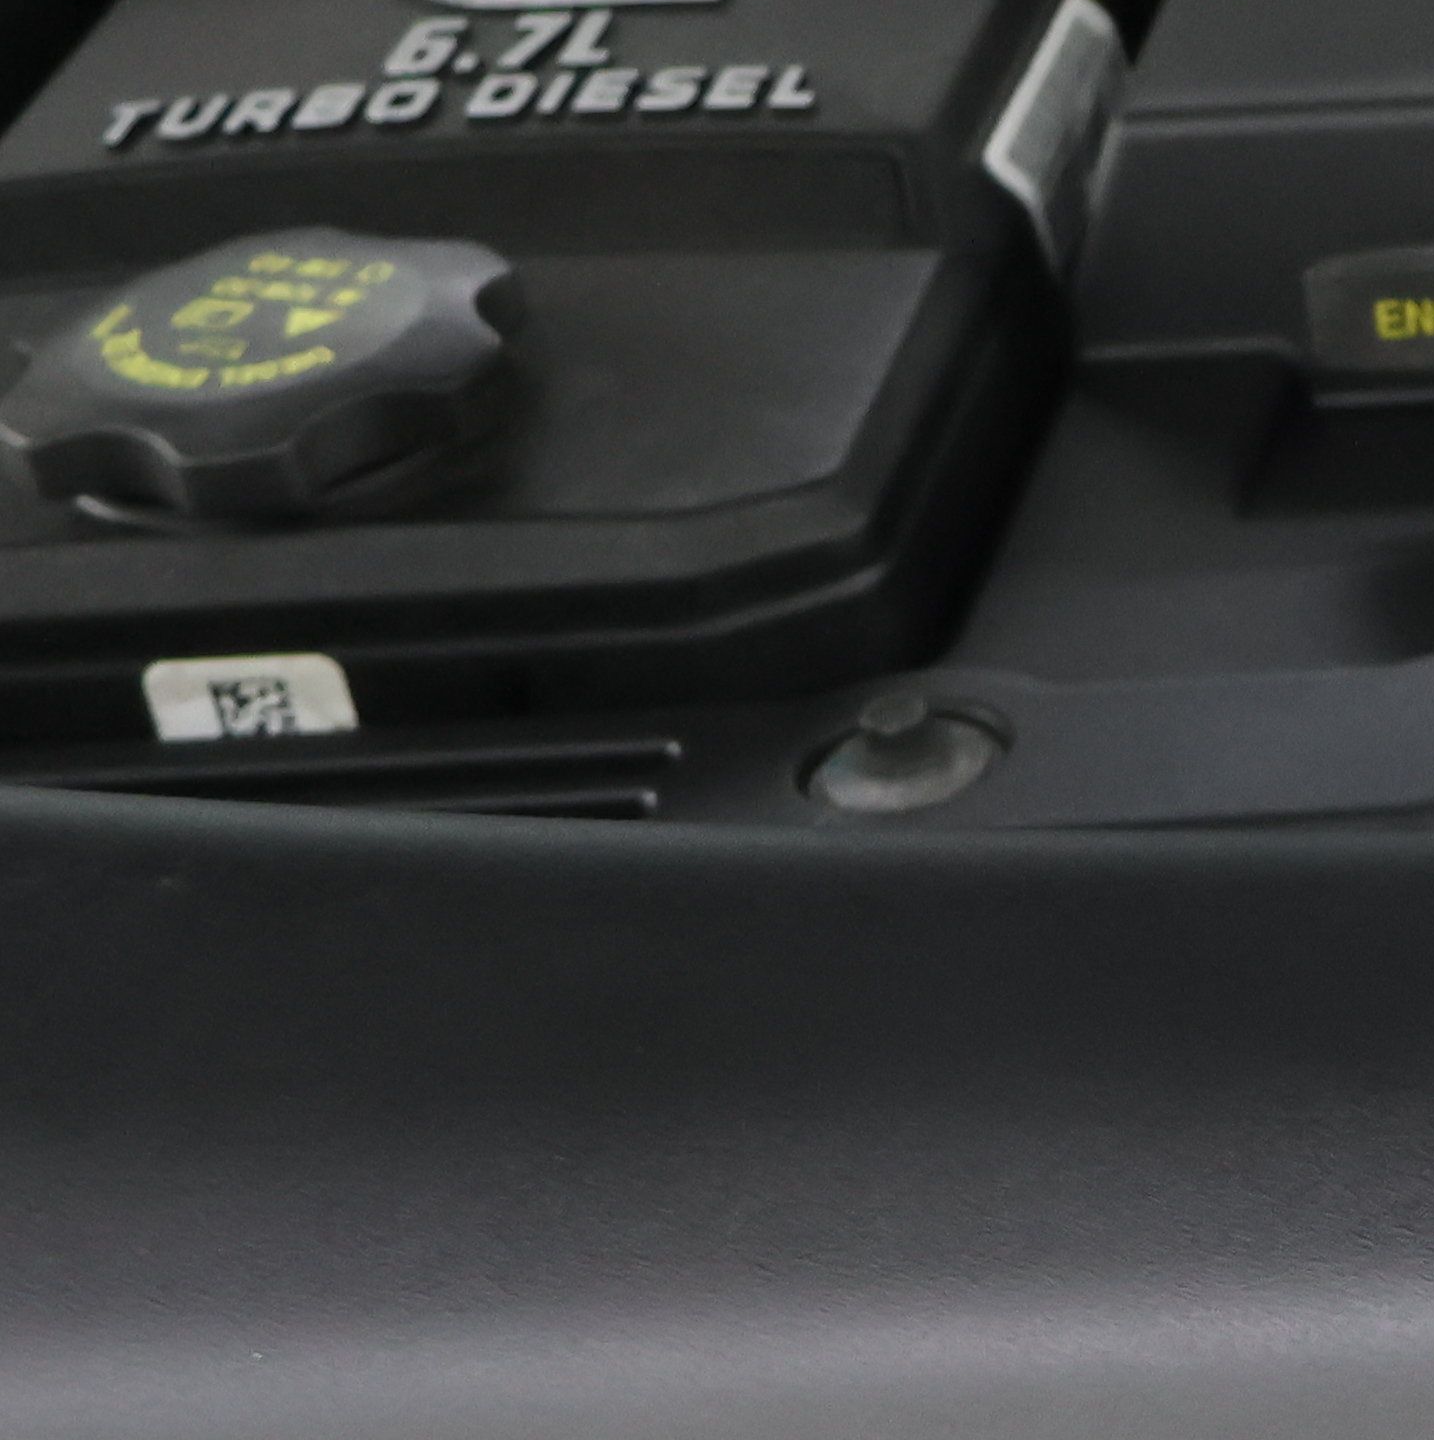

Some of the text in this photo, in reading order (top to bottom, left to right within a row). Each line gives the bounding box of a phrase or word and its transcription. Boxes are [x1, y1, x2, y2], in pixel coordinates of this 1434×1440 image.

[384, 8, 613, 75] 6.7L
[102, 64, 817, 148] TURBO DIESEL
